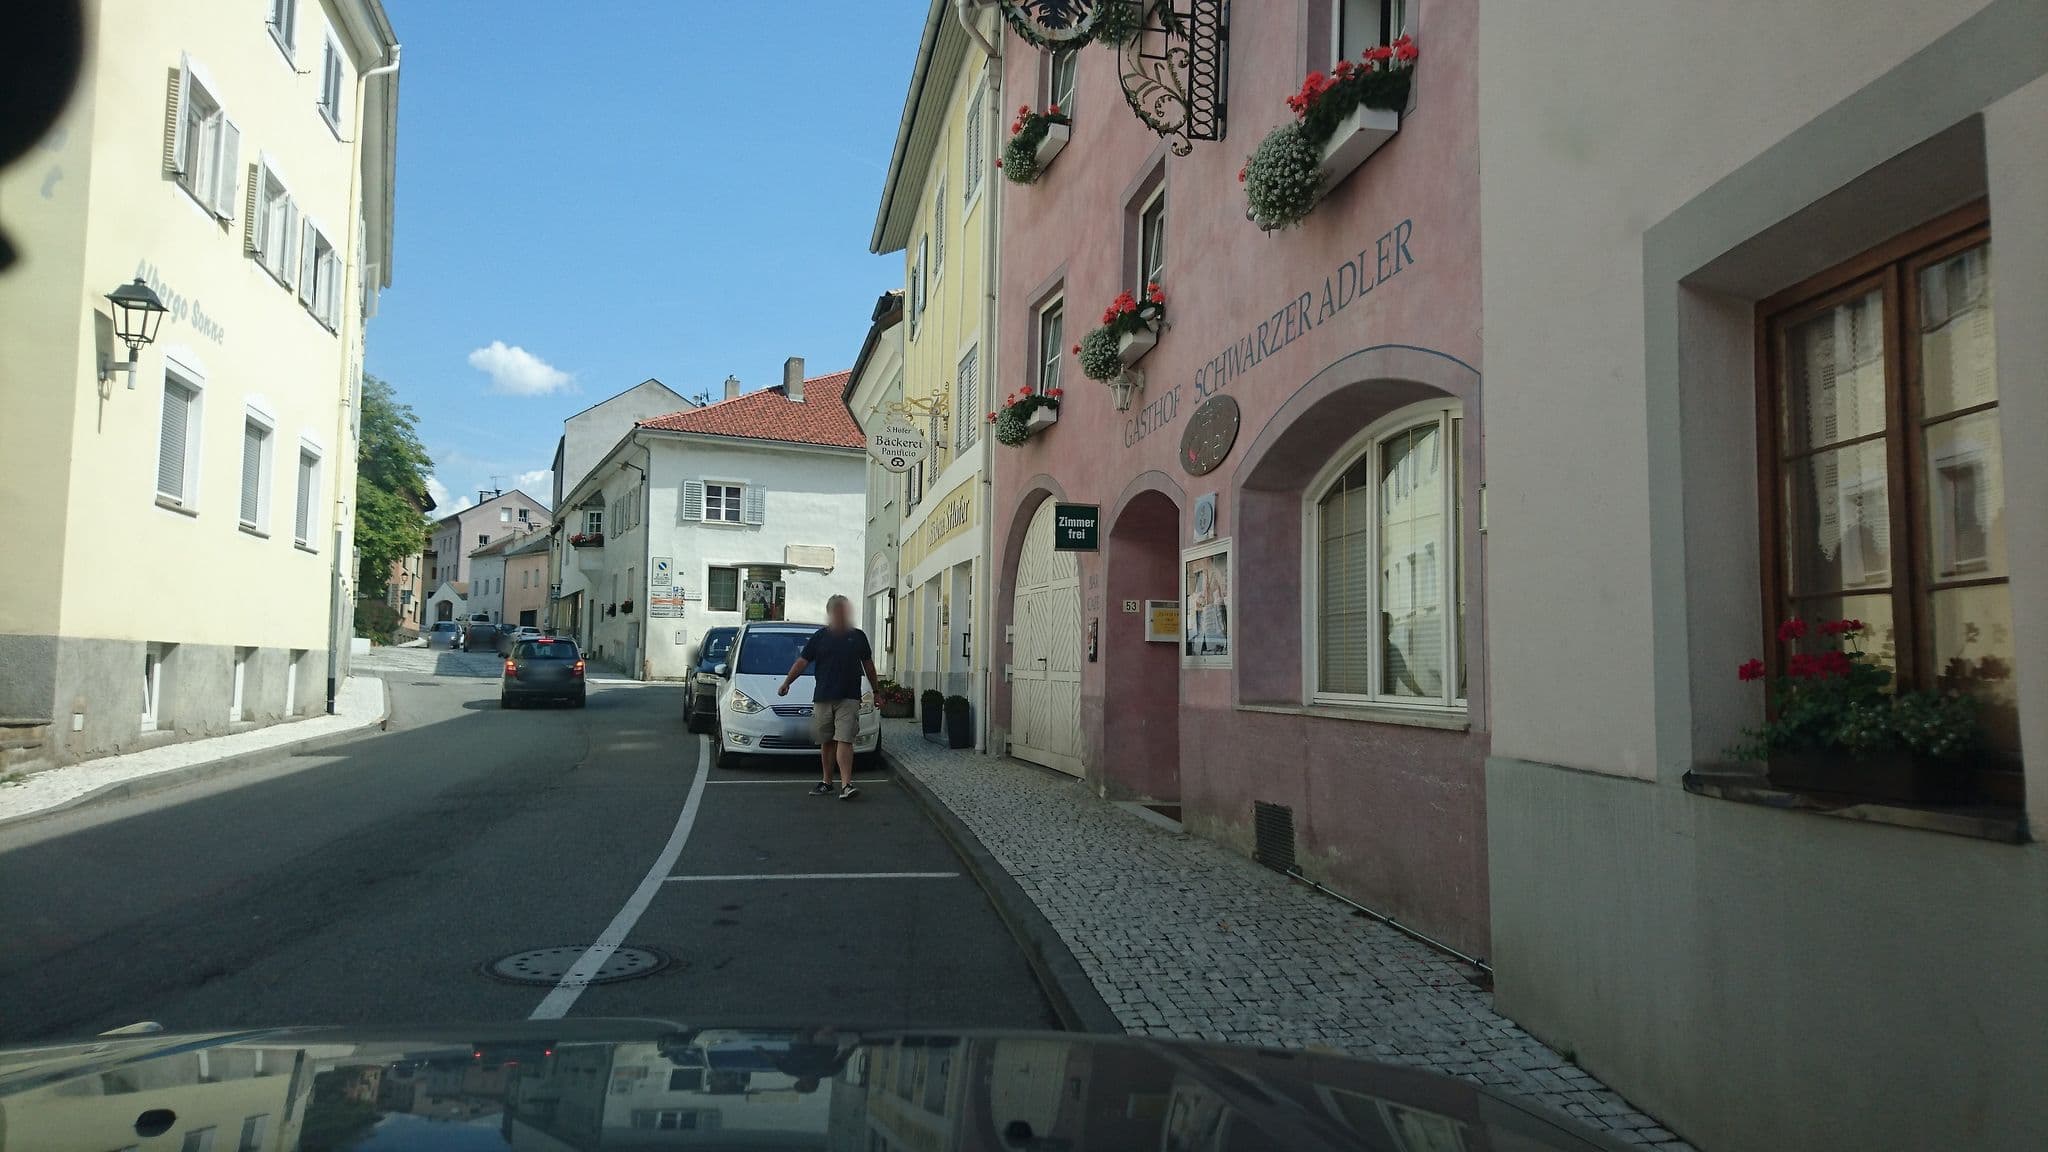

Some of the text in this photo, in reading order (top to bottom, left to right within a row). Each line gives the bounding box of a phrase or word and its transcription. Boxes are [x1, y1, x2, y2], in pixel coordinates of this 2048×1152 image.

[135, 256, 225, 346] Albergo Sonne
[1123, 383, 1181, 450] GASTHOF
[1194, 290, 1313, 405] SCHWARZER
[1317, 217, 1416, 326] ADLER
[875, 435, 924, 449] Bäckerei
[1058, 516, 1096, 528] Zimmer
[1067, 528, 1086, 540] frei
[1125, 600, 1138, 612] 53
